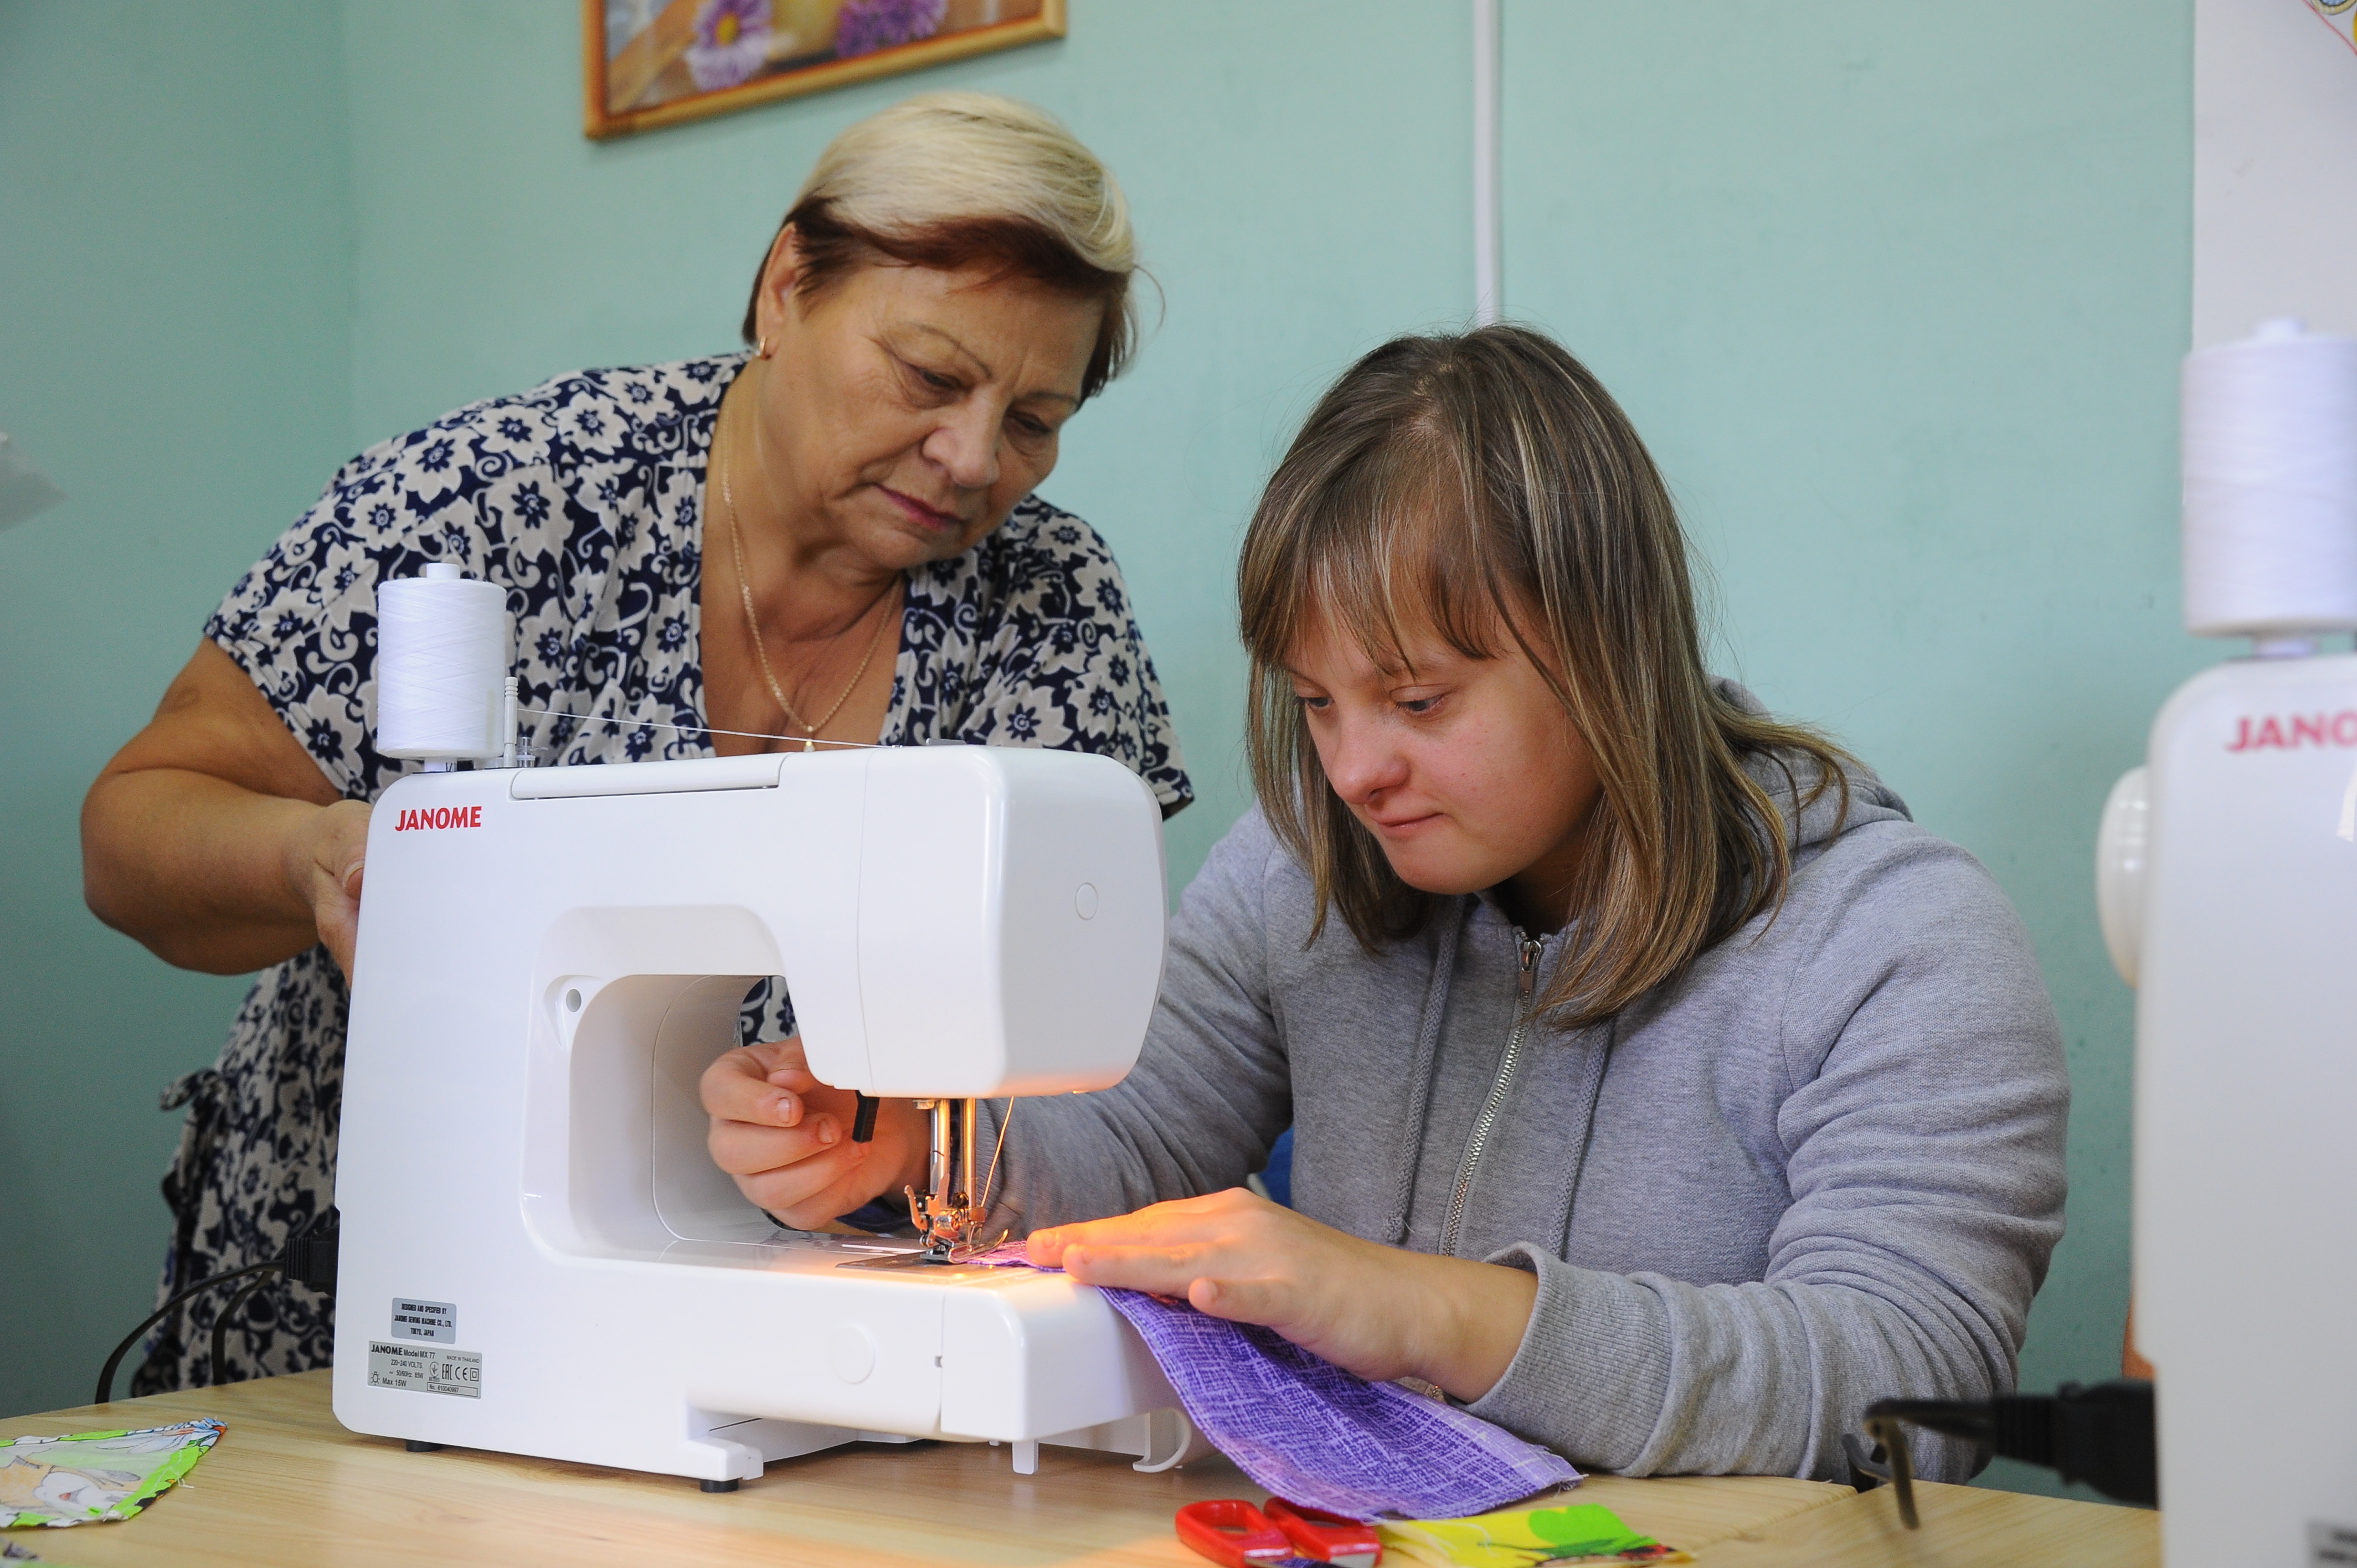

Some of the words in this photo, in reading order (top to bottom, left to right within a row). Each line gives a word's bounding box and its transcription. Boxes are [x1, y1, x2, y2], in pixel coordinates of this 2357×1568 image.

[395, 806, 482, 831] JANOME
[421, 1317, 436, 1325] MACHINE
[410, 1327, 423, 1336] TOKYO,
[371, 1344, 403, 1355] JANOME
